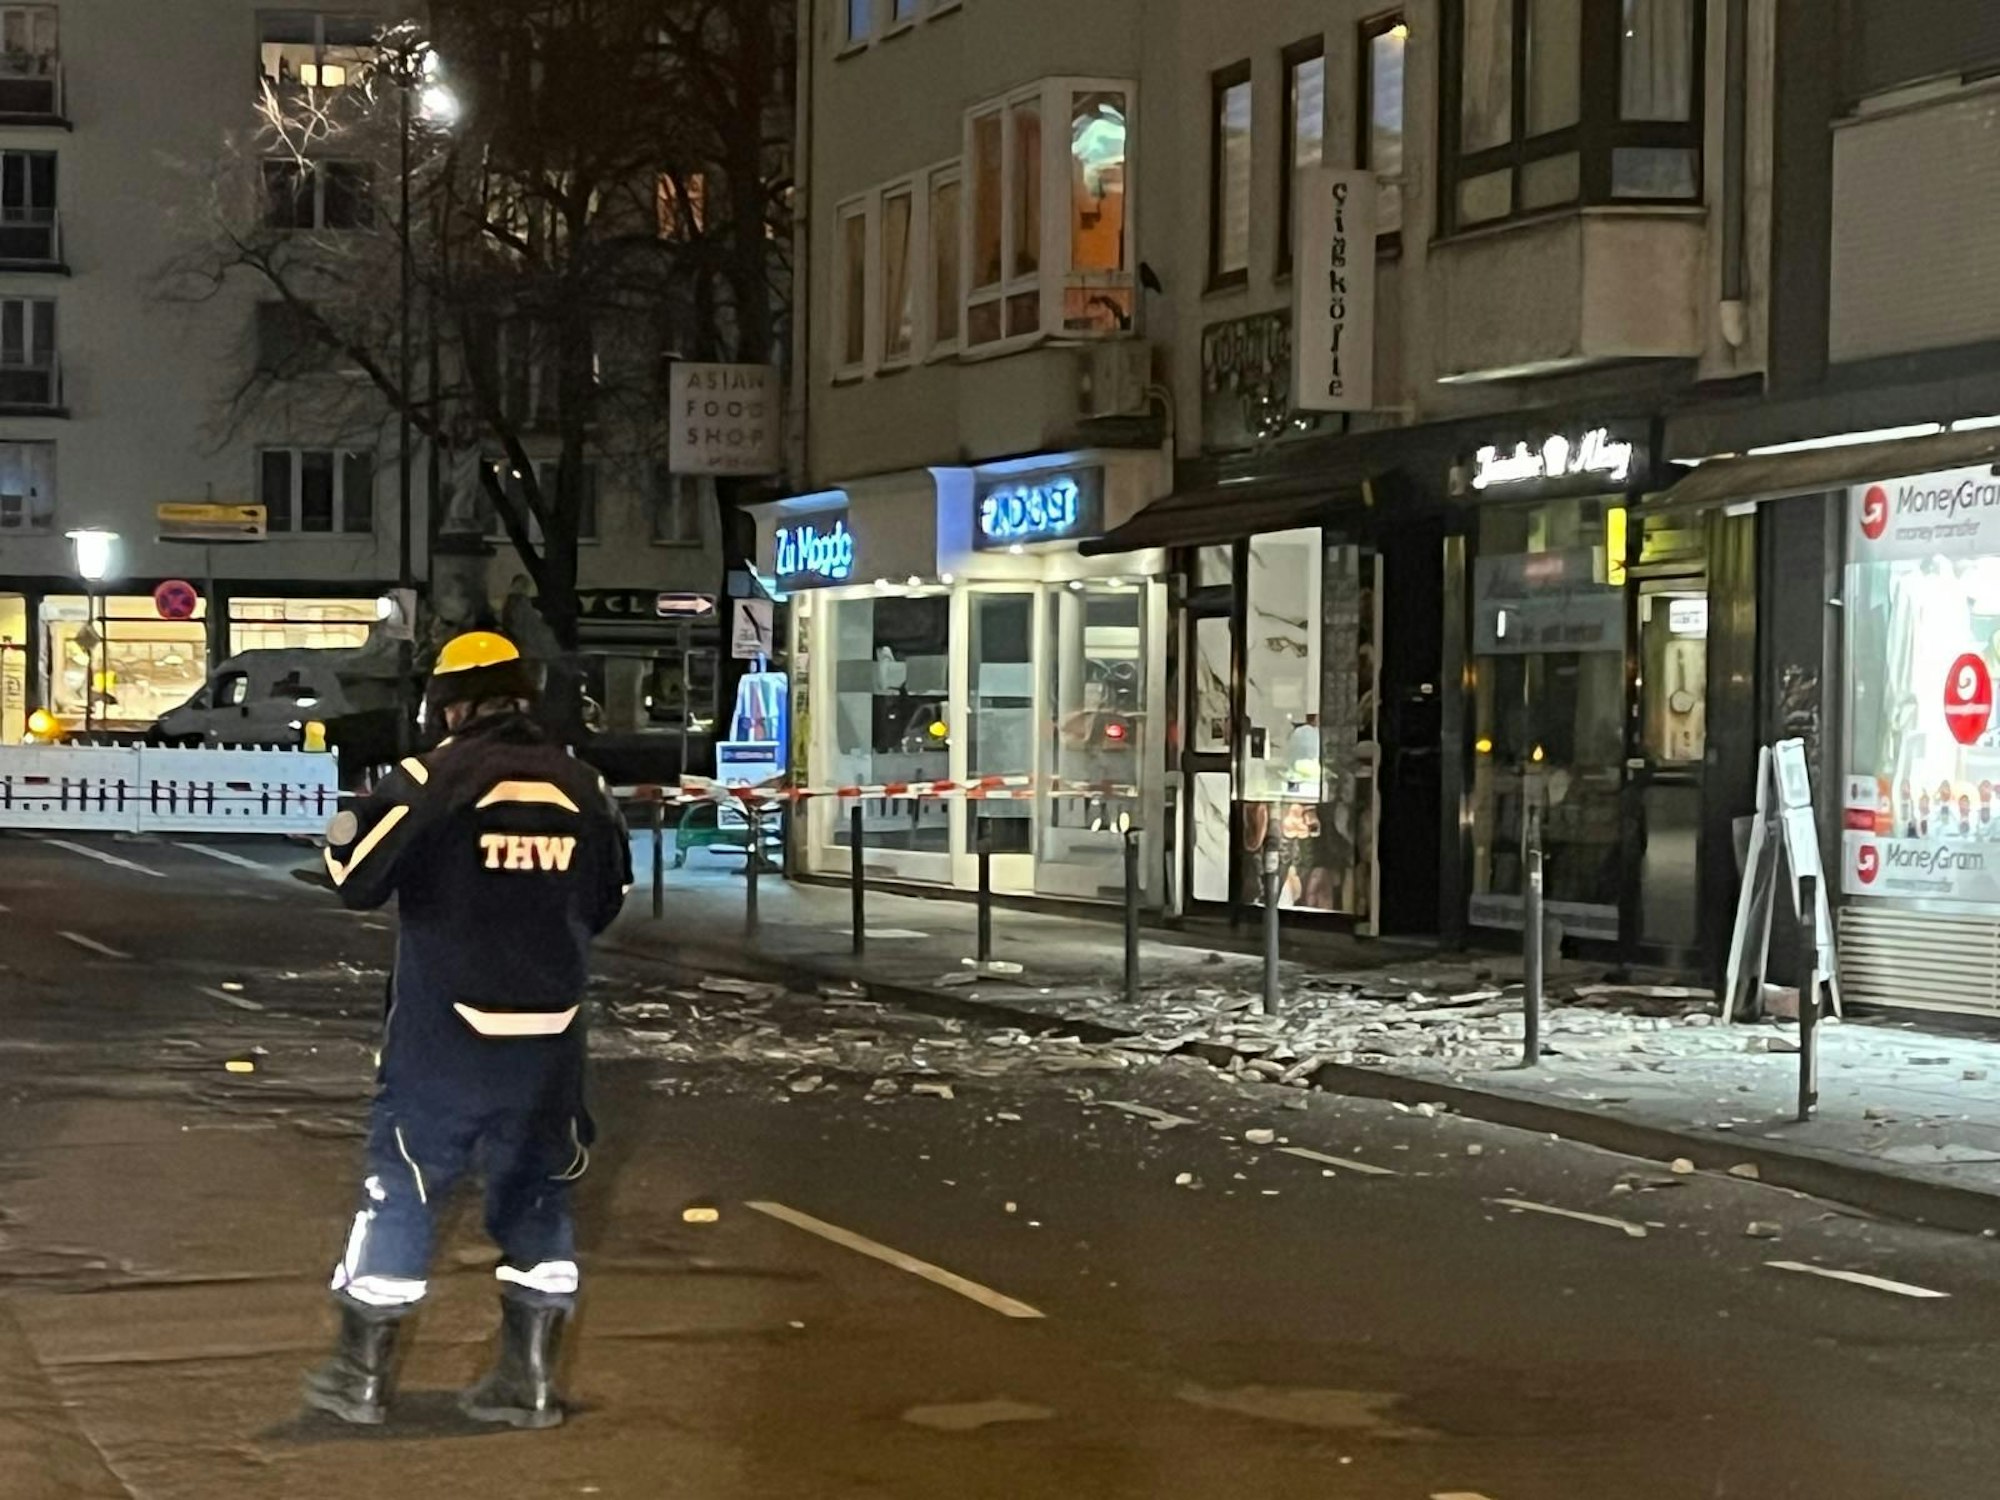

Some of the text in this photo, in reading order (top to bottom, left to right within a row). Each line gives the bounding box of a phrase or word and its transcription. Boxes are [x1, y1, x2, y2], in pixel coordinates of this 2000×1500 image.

[687, 371, 764, 391] ASIAN
[687, 428, 763, 447] SHOP
[480, 834, 577, 871] THW
